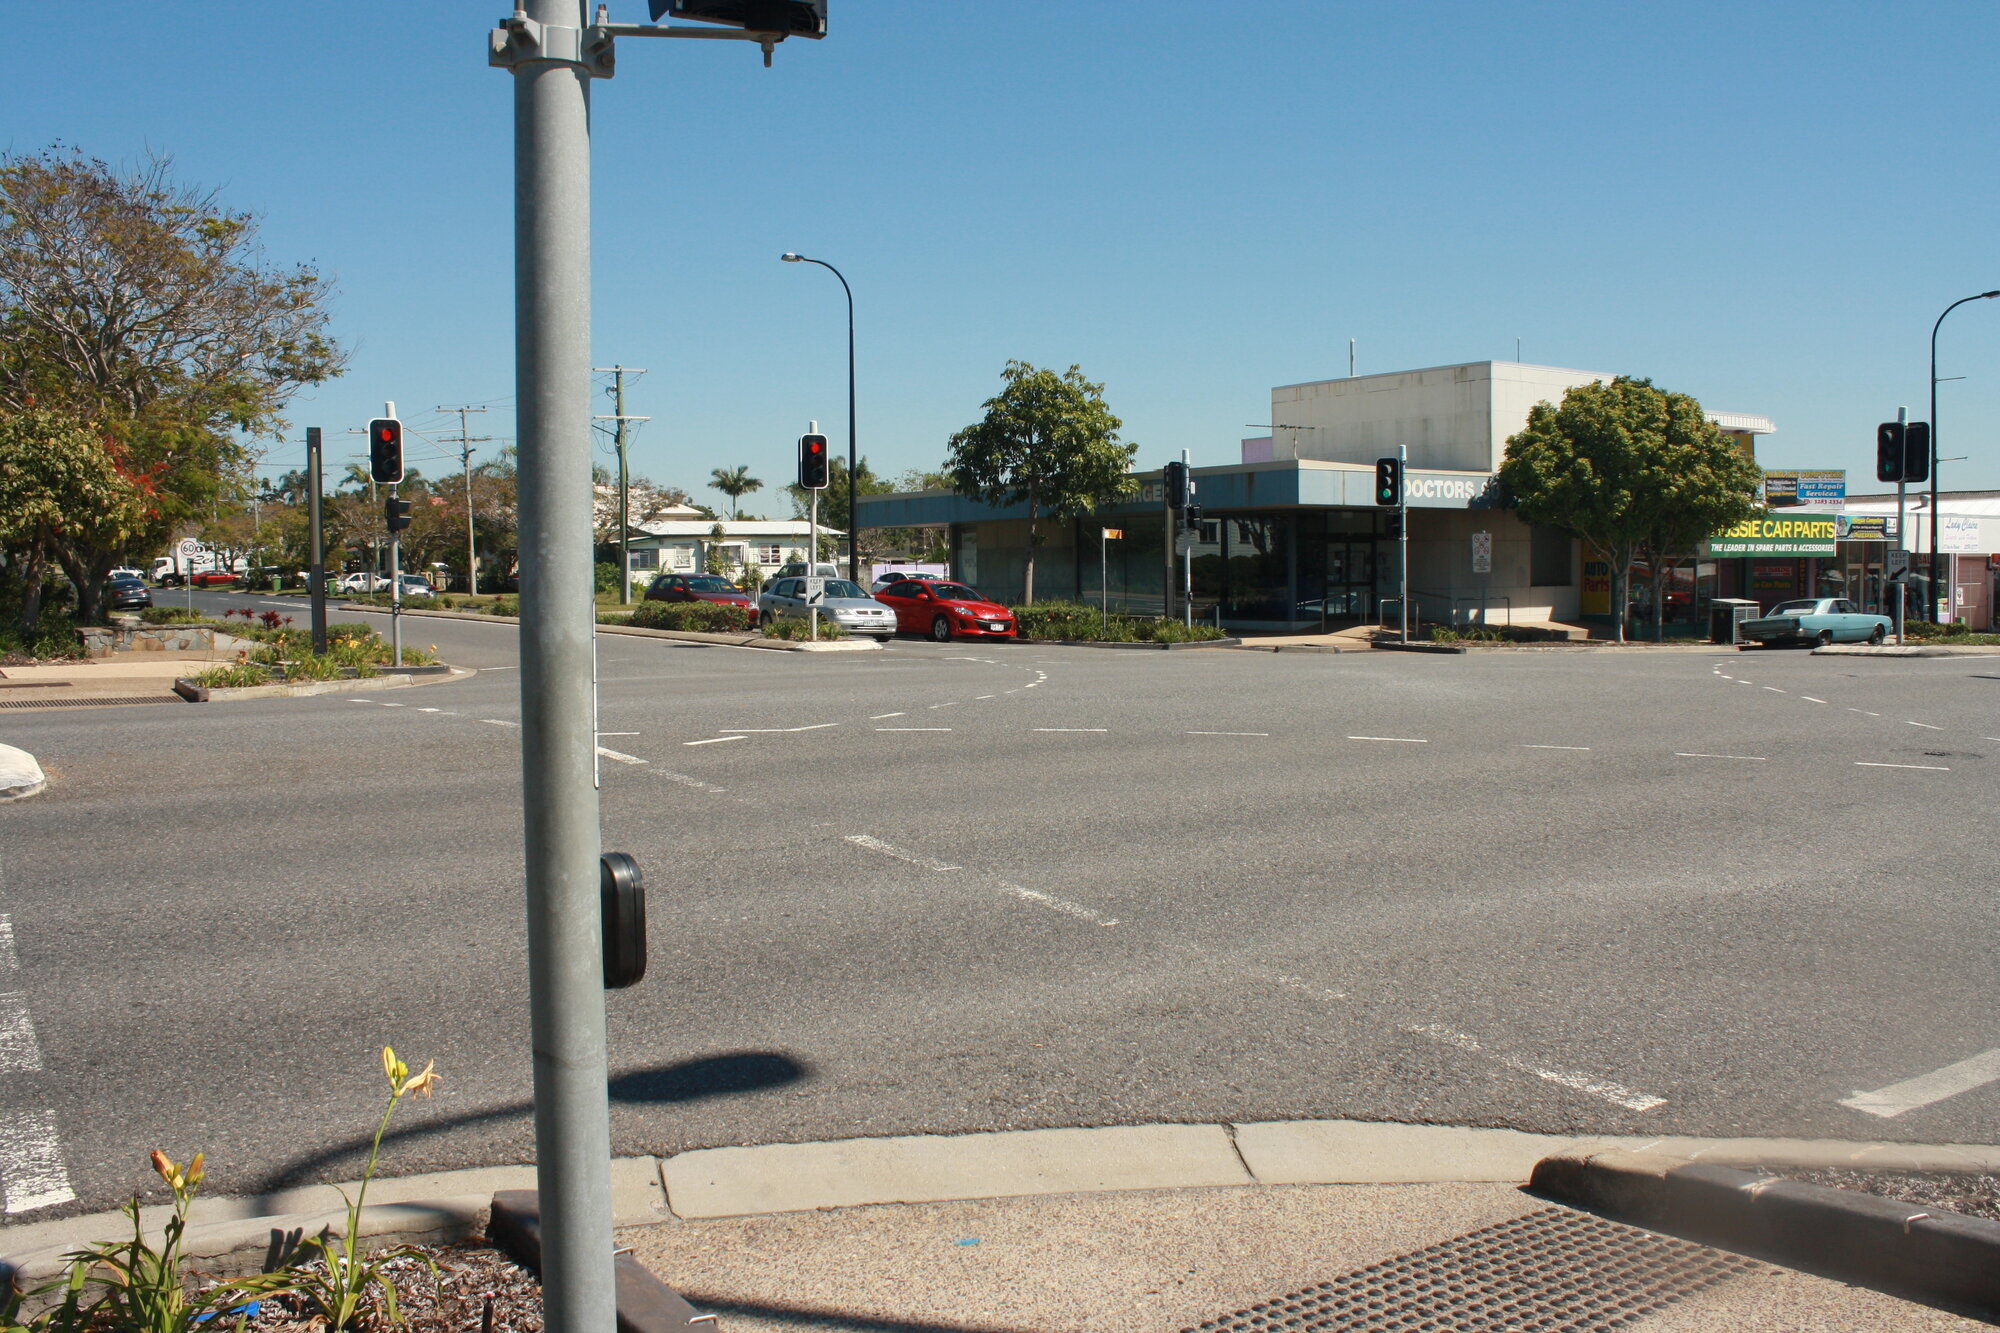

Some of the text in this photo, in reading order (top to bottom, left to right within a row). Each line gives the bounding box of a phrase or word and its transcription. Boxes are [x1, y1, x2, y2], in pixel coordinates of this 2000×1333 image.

[1404, 479, 1475, 499] DOCTORS
[1763, 520, 1793, 538] CAR
[1794, 521, 1835, 539] PARTS
[1710, 544, 1722, 552] THE
[1723, 544, 1746, 552] LEADER
[1746, 544, 1754, 552] IN
[1755, 544, 1774, 552] SPARE
[1774, 544, 1792, 552] PARTS
[1584, 561, 1608, 576] AUTO
[1584, 577, 1609, 592] Parts
